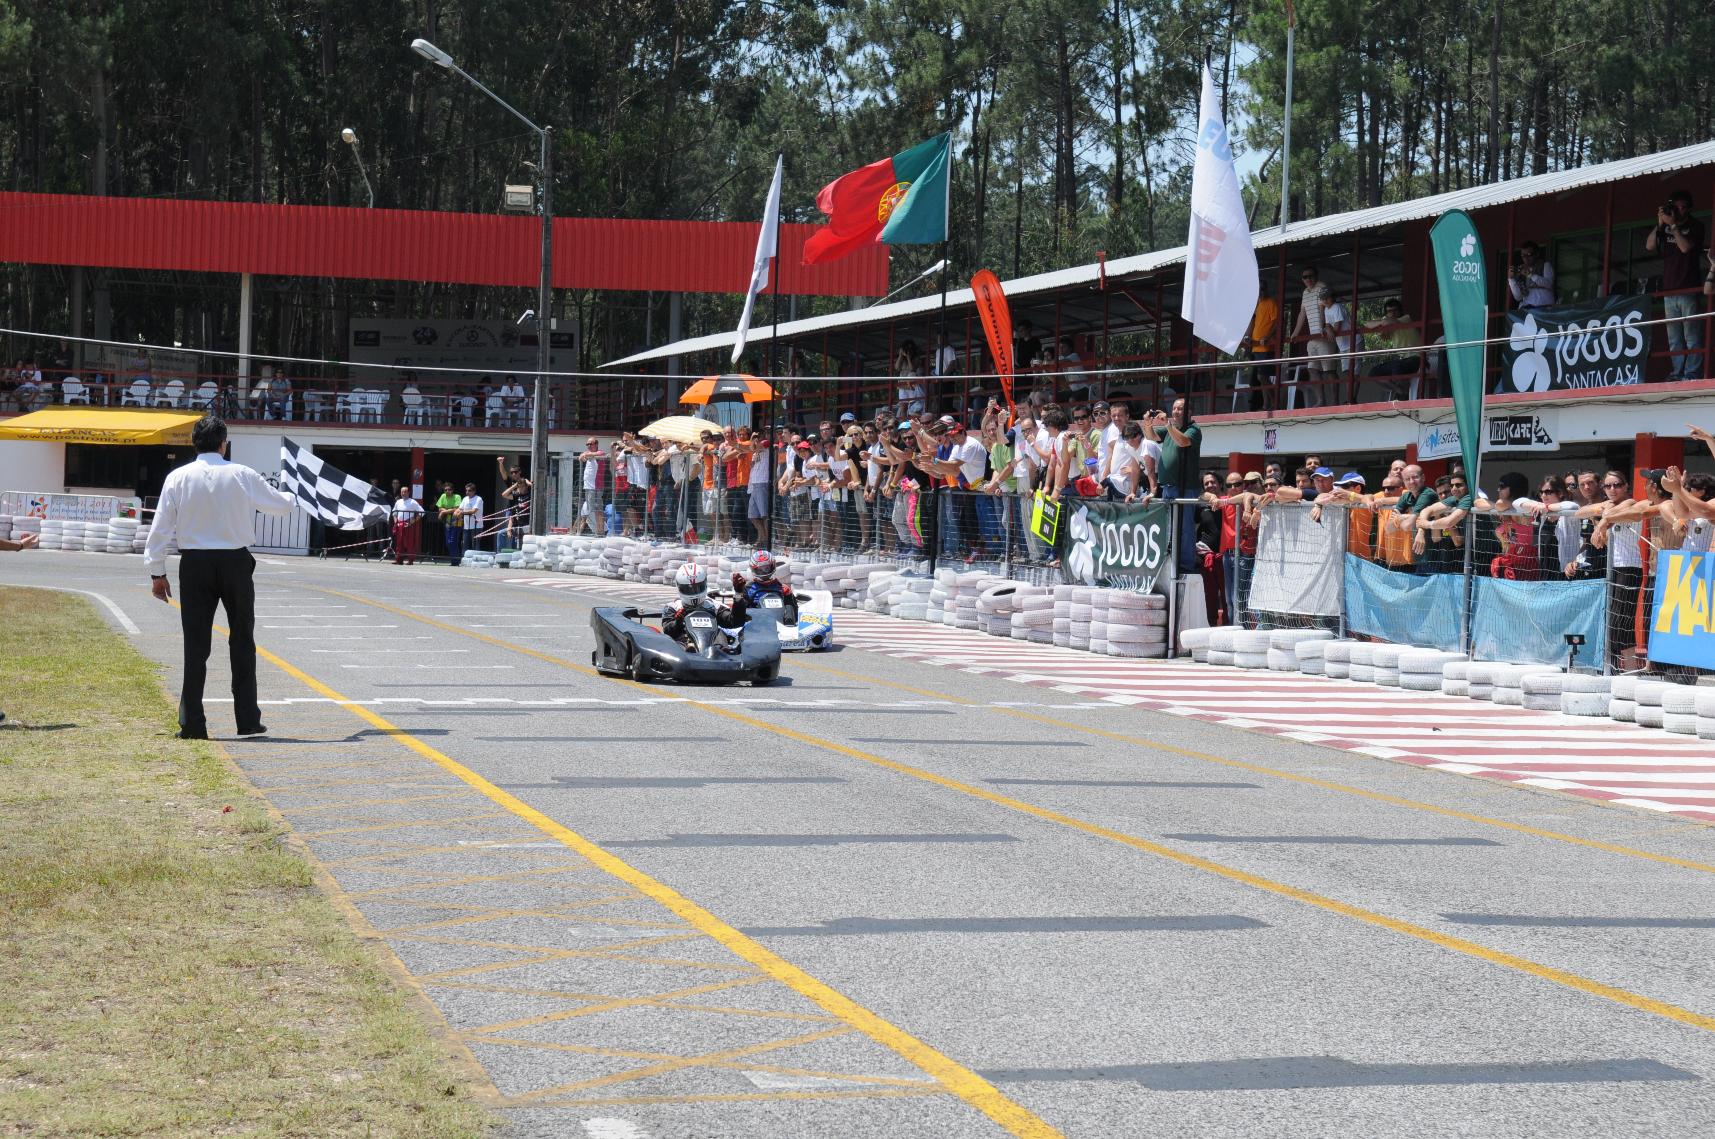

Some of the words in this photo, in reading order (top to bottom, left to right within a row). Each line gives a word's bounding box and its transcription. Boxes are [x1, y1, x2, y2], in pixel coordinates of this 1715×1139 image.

[1555, 310, 1643, 384] JOGOS
[1565, 364, 1639, 389] SANTACASA
[1098, 522, 1160, 578] JOGOS
